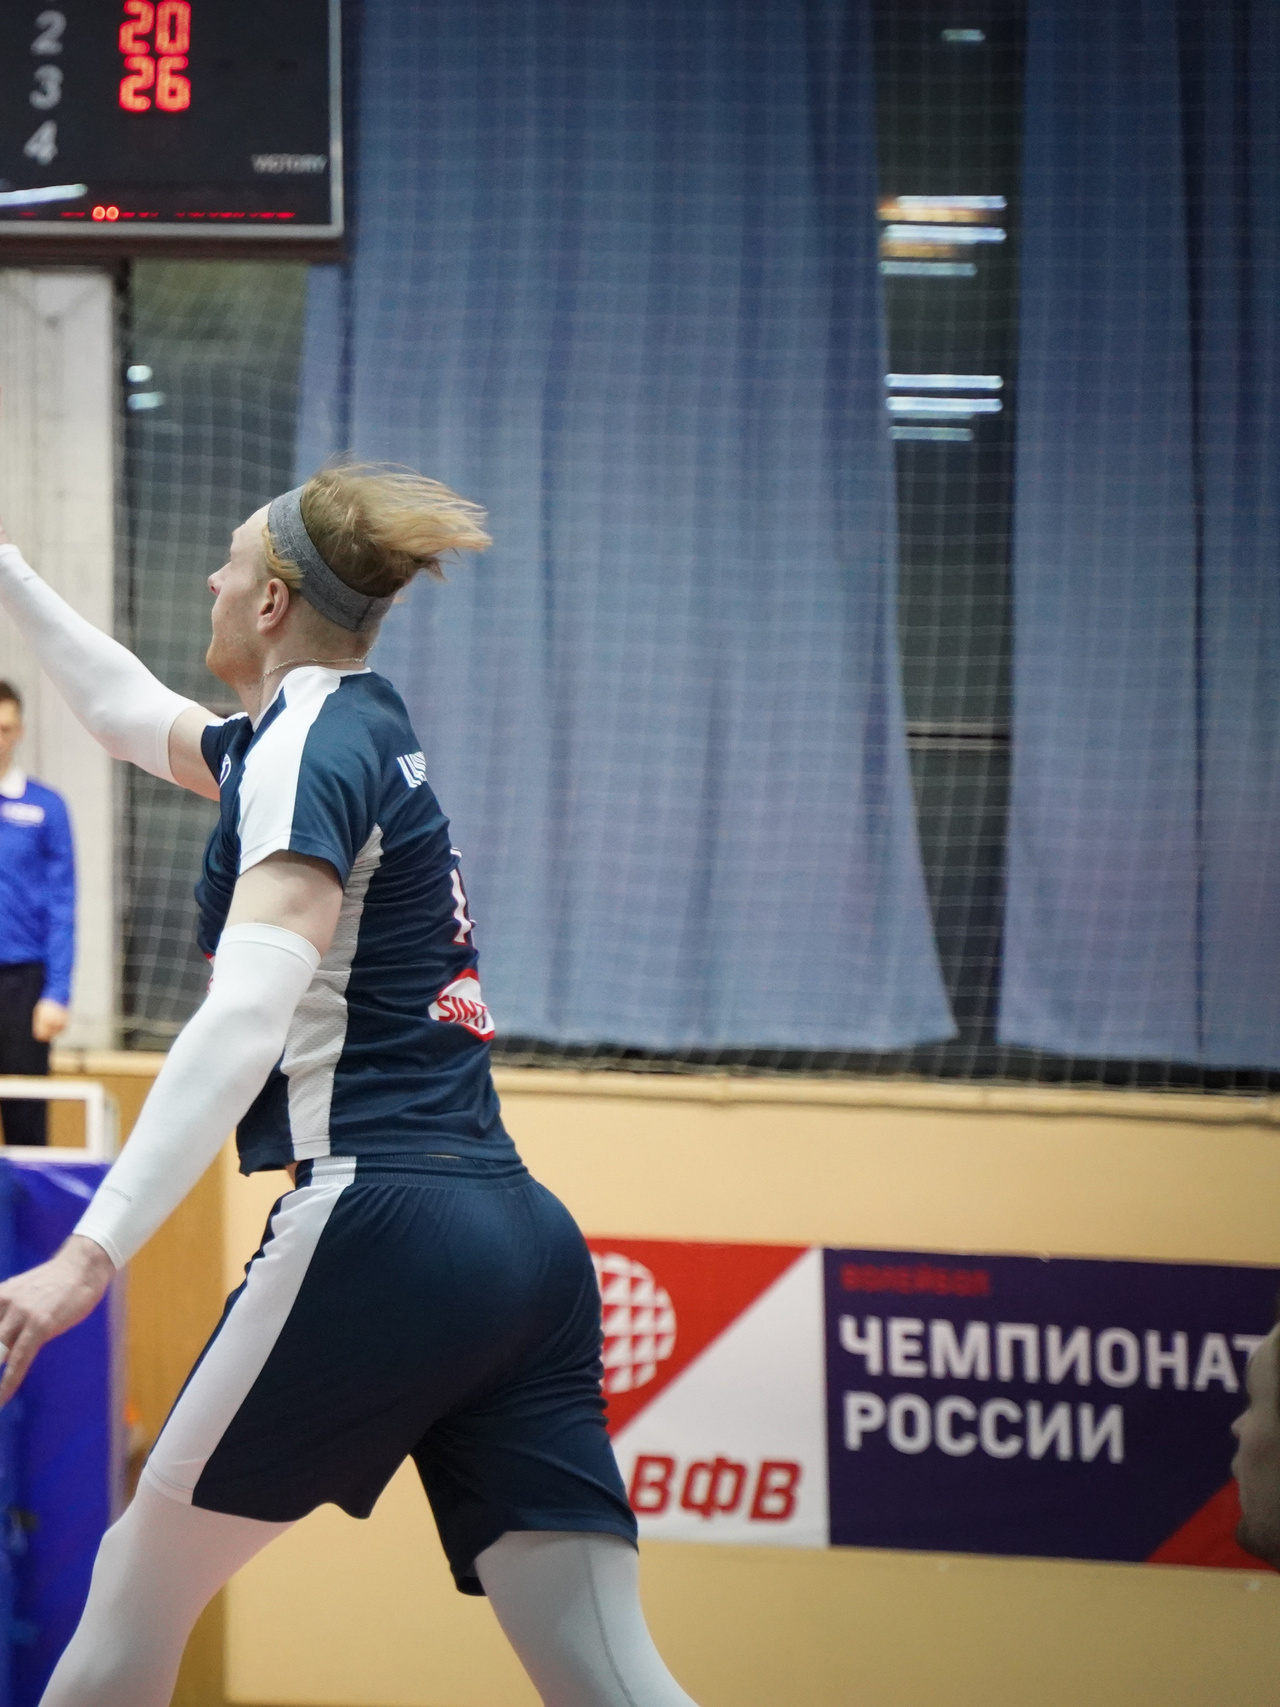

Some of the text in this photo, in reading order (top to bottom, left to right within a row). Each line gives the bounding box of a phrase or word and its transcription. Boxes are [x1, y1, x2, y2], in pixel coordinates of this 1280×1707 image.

[29, 9, 67, 55] 2
[119, 0, 192, 55] 20
[29, 64, 64, 110] 3
[119, 55, 192, 112] 26
[23, 119, 58, 166] 4
[843, 1390, 1126, 1463] РОССИИ
[630, 1453, 803, 1523] ВФВ
